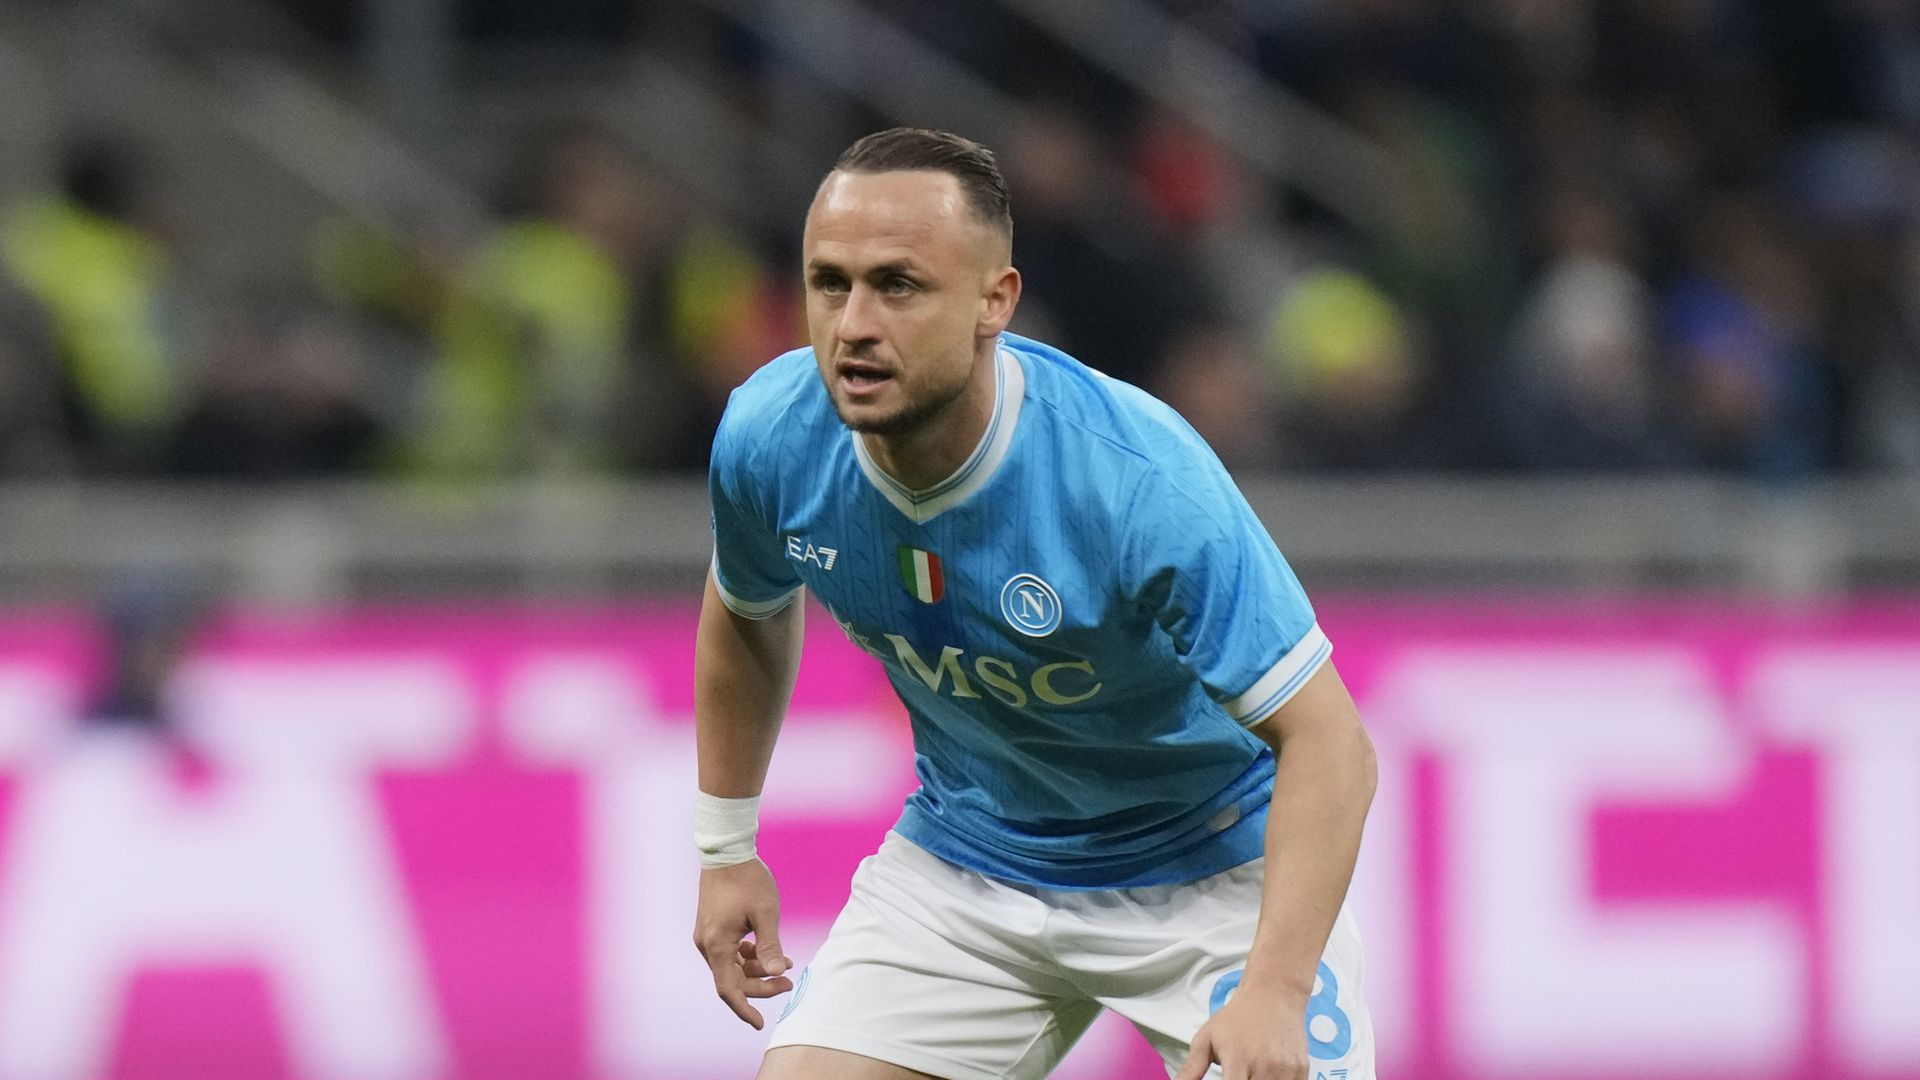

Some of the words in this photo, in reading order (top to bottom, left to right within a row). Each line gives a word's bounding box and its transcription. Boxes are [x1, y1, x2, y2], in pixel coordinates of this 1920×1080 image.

[787, 535, 837, 571] EA7
[1018, 590, 1045, 620] N
[883, 633, 1103, 709] MSC
